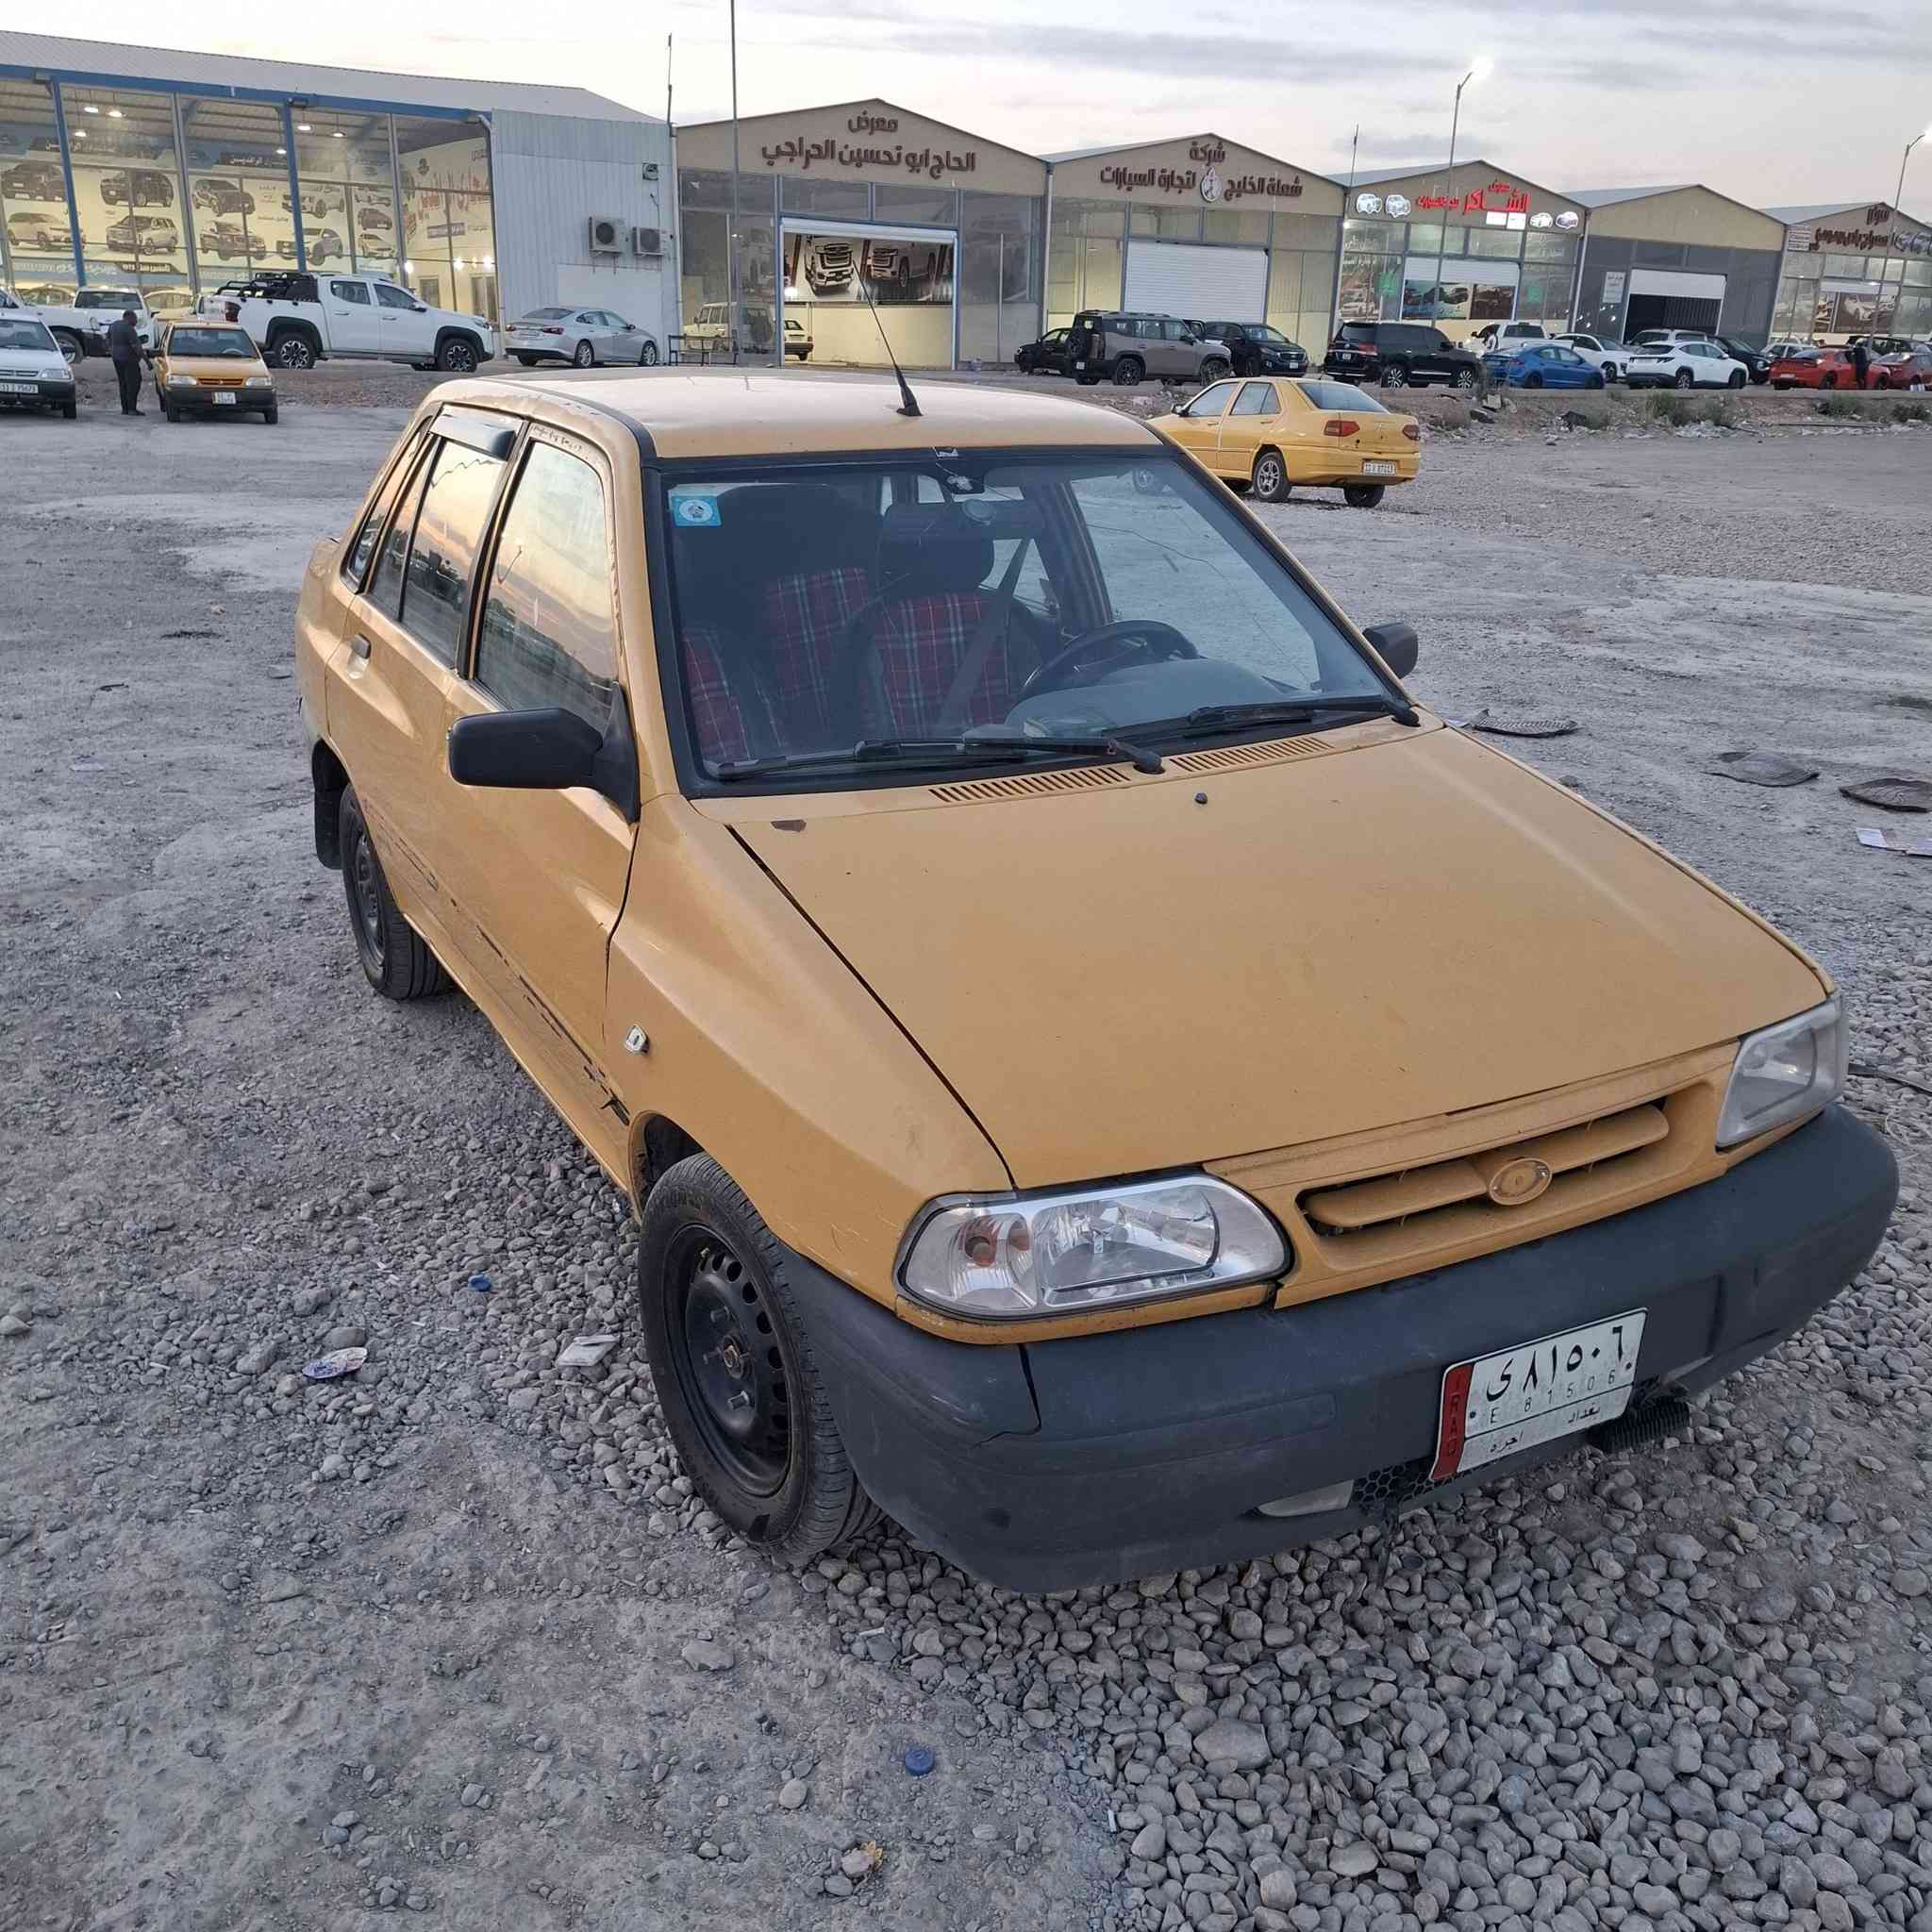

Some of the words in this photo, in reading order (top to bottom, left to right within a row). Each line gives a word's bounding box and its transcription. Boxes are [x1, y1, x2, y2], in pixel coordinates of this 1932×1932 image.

[848, 110, 898, 136] معرض
[839, 144, 903, 168] تحسين
[906, 149, 930, 173] ابو
[929, 151, 976, 178] الحاج
[1190, 142, 1226, 166] شركة
[1100, 166, 1156, 192] السيارات
[1158, 169, 1196, 194] لتجارة
[1224, 176, 1267, 201] الخليج
[1267, 176, 1303, 197] شعلة
[1463, 187, 1531, 215] الشاكر
